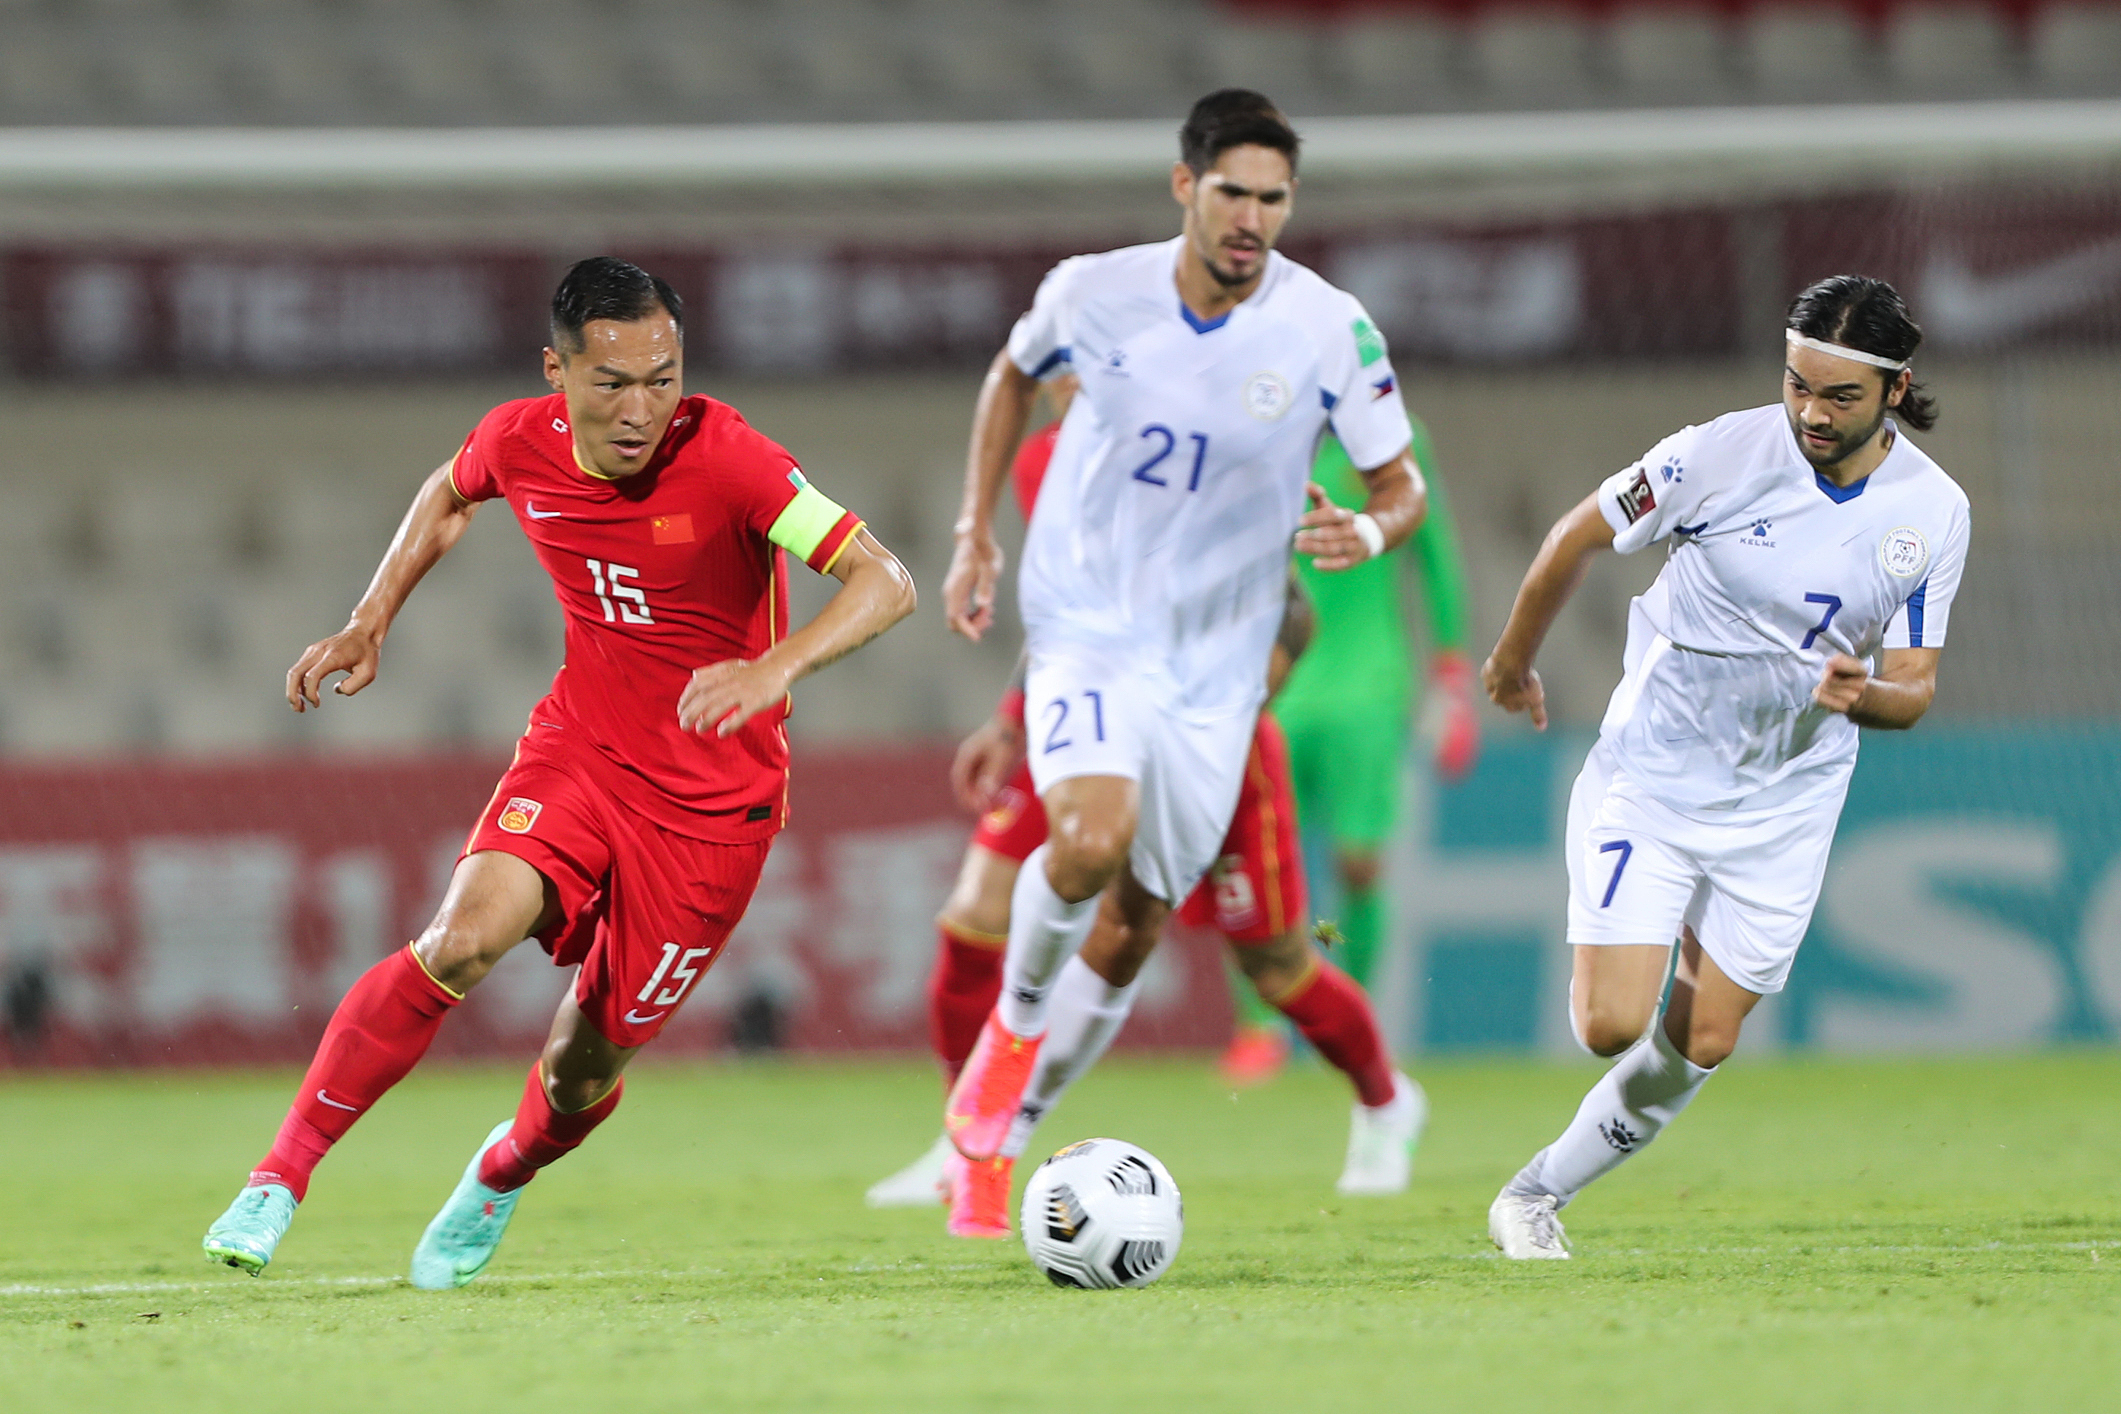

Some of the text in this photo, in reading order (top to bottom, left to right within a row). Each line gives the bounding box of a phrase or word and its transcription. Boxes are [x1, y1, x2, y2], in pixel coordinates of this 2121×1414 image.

[1133, 424, 1208, 491] 21
[1740, 537, 1776, 548] KELME
[1893, 554, 1915, 564] PFF
[586, 559, 656, 624] 15
[1800, 592, 1842, 649] 7
[1042, 690, 1105, 754] 21
[1599, 840, 1633, 908] 7
[637, 942, 711, 1005] 15
